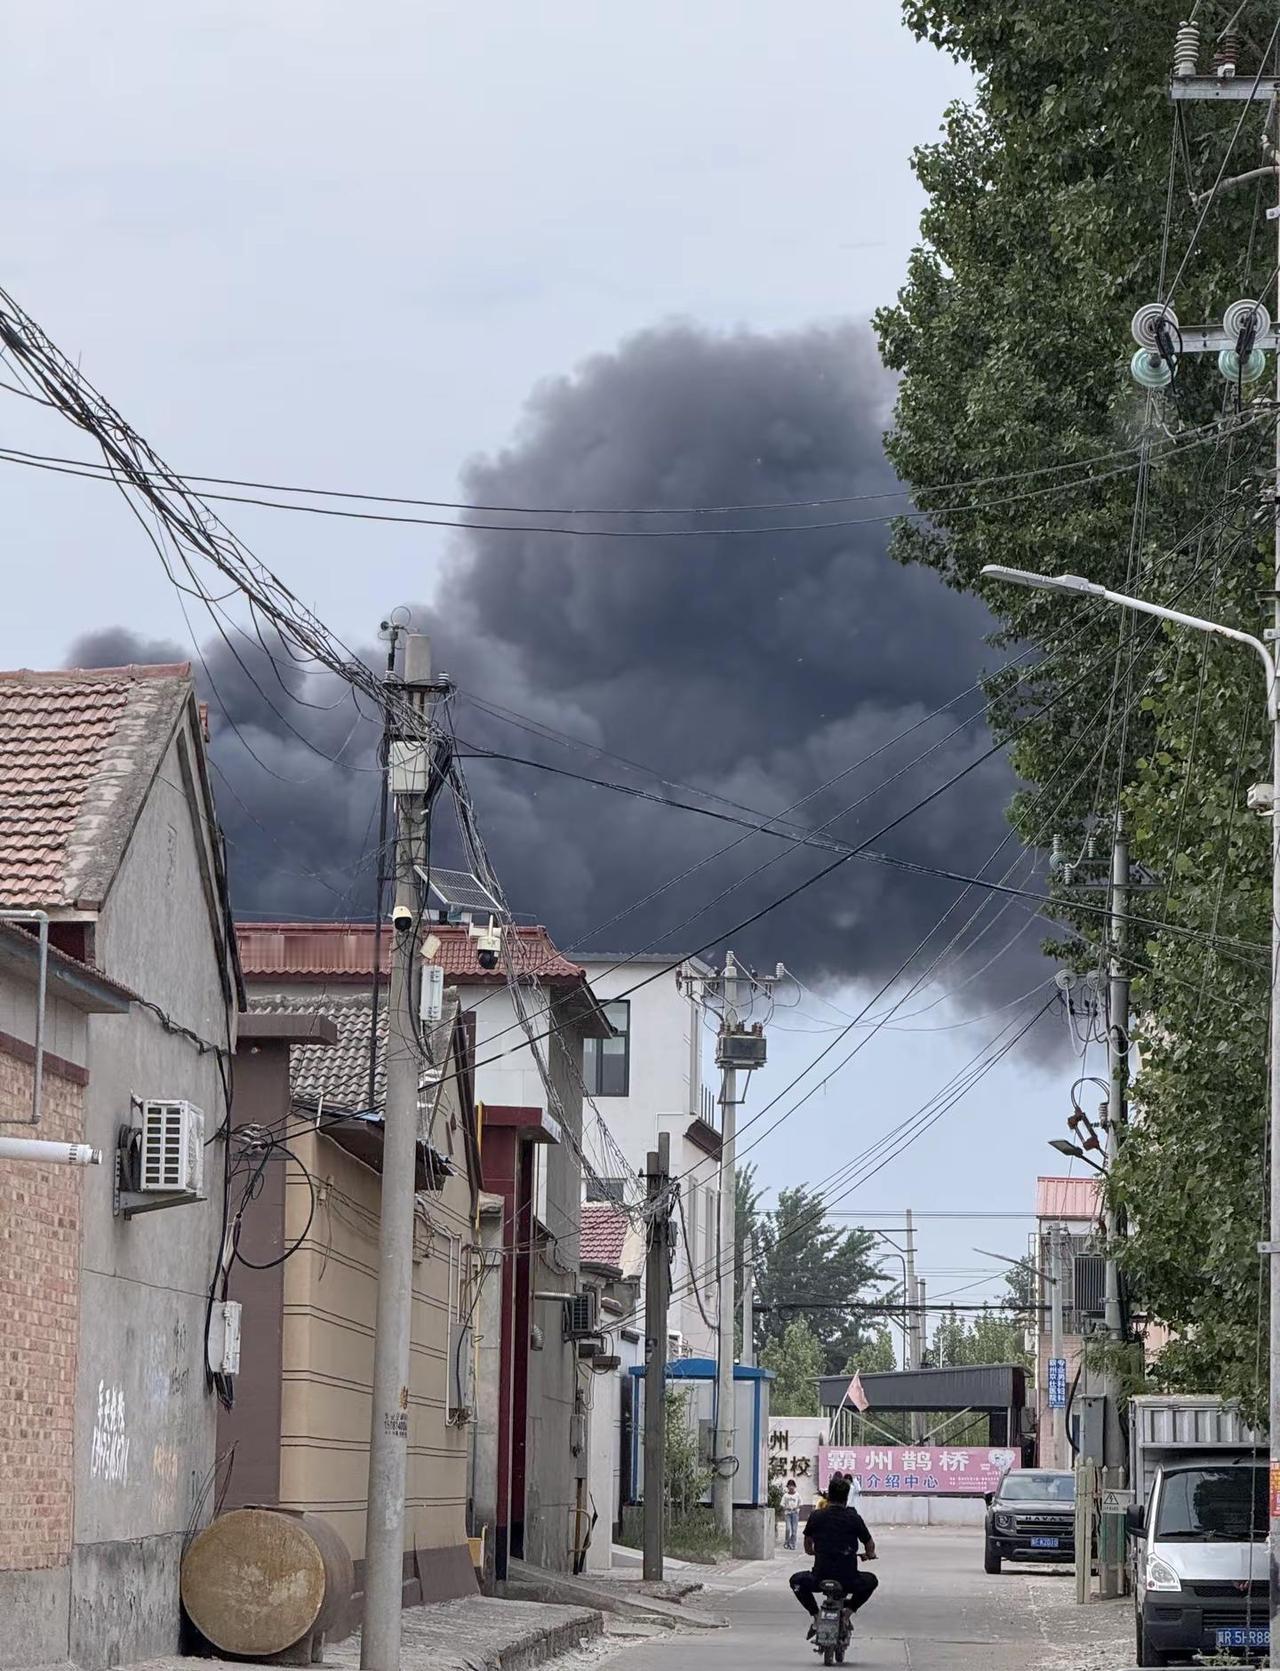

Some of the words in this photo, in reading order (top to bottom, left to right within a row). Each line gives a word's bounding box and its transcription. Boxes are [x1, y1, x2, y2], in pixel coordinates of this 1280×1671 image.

[768, 1456, 811, 1478] 驾校
[827, 1451, 970, 1471] 霸州鹊桥
[828, 1474, 939, 1489] 介绍中心
